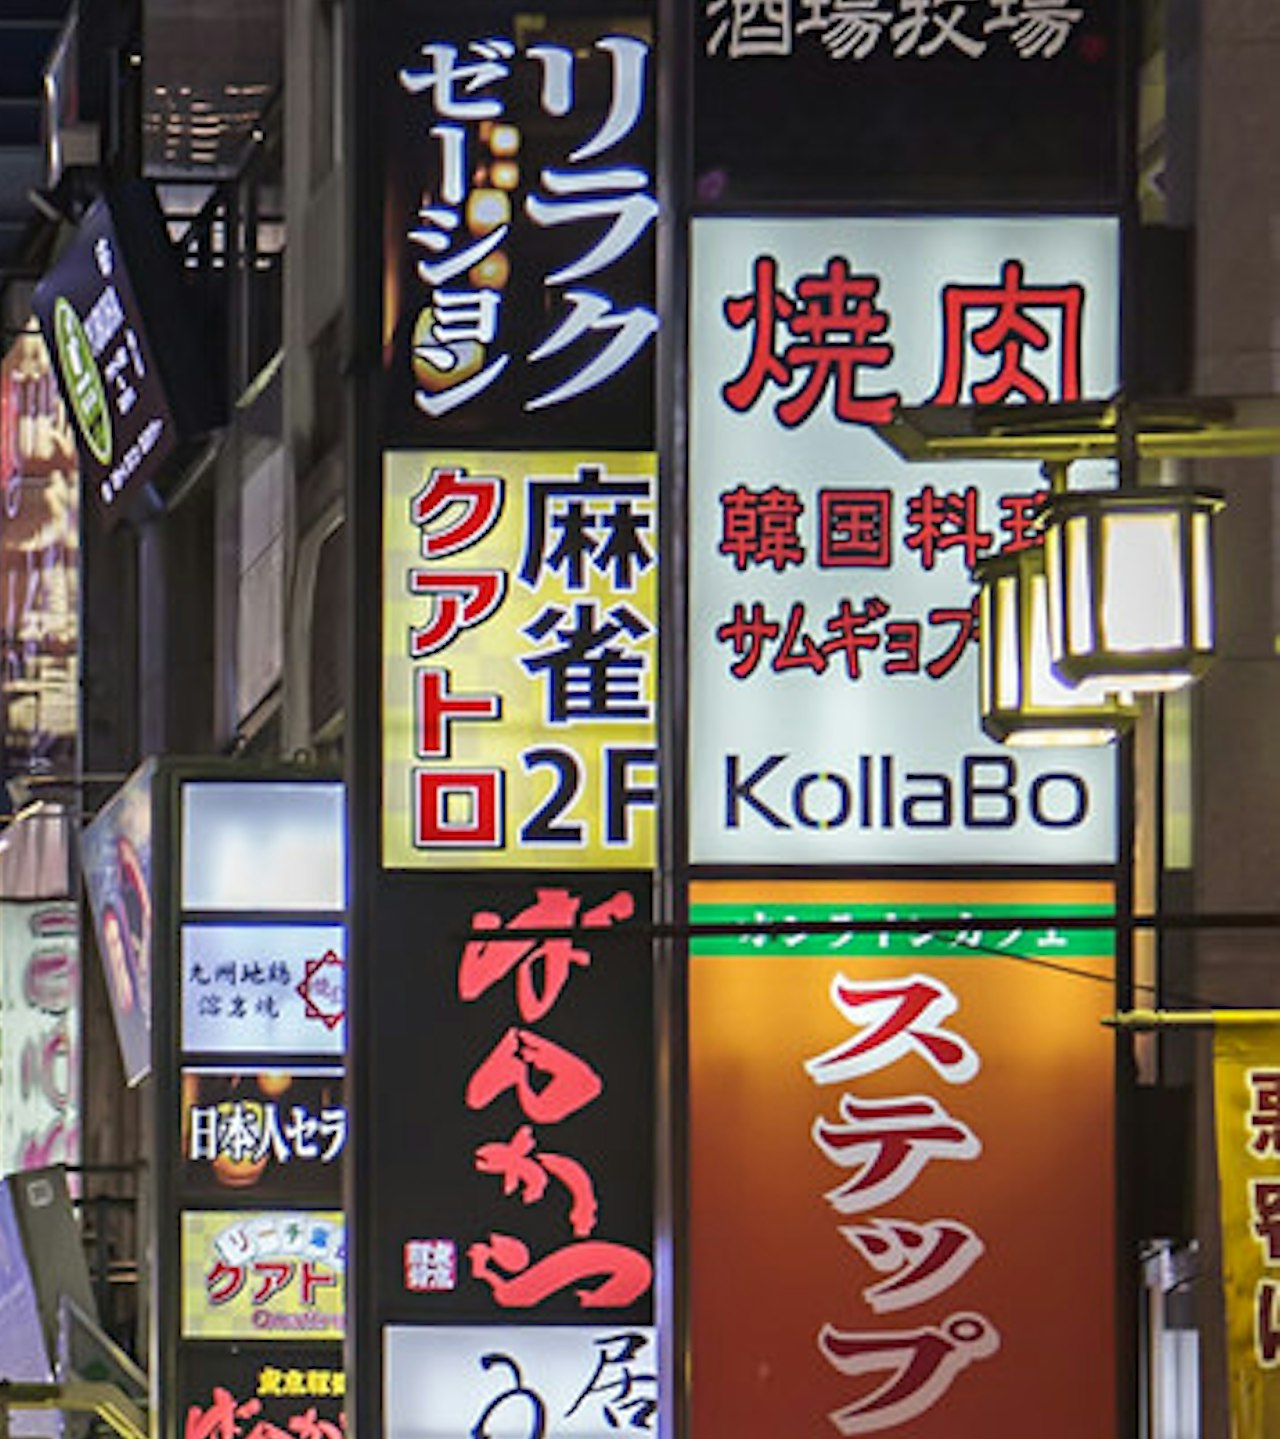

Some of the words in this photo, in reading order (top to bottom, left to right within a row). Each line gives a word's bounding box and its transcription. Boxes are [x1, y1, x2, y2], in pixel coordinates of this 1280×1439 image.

[400, 44, 508, 418] ゼーション
[524, 36, 660, 413] リラク
[722, 255, 1085, 428] 焼肉
[408, 468, 506, 852] クアトロ
[520, 466, 650, 724] 麻雀
[520, 748, 654, 844] 2F
[723, 754, 1090, 830] KollaBo
[804, 972, 1000, 1438] ステップ
